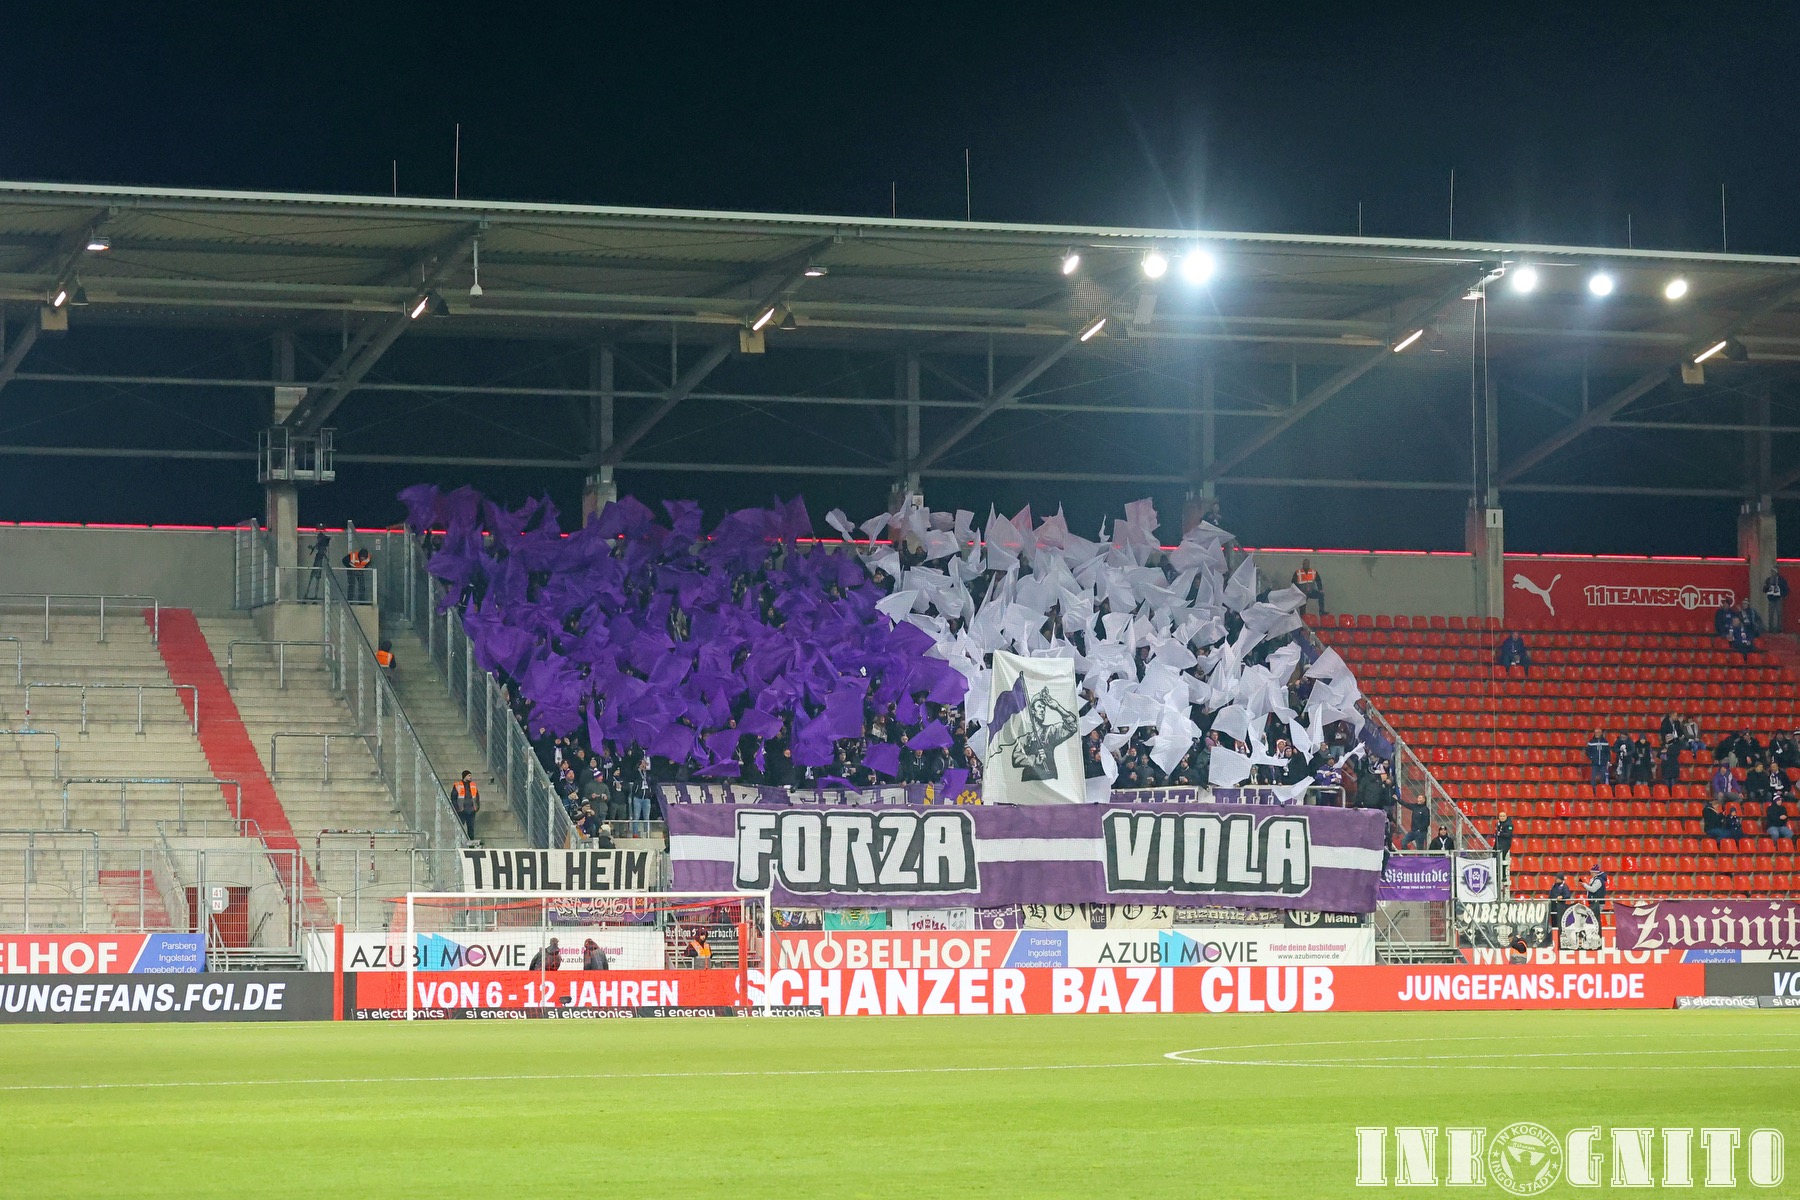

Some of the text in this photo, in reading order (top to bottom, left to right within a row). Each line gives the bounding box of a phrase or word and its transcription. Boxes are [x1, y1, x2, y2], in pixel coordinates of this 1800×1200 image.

[736, 810, 1310, 896] FORZA VIOLA
[464, 850, 648, 891] THALHEIM
[1379, 869, 1450, 882] Wismutadle
[213, 889, 222, 898] 41
[1324, 913, 1358, 925] Mann
[1463, 902, 1546, 925] OLBERNHAU
[161, 942, 197, 951] Parsberg
[1030, 938, 1062, 947] Parsberg
[1027, 949, 1062, 958] Ingolstadt
[1098, 941, 1258, 963] AZUBI MOVIE
[1269, 944, 1347, 953] Finde deine Ausbildung!
[0, 942, 117, 973] LHOF
[158, 954, 197, 963] Ingolstadt
[440, 945, 526, 967] MOVIE
[144, 966, 197, 974] moebelhof.de
[735, 966, 1335, 1016] SCHANZER BAZI CLUB
[1398, 973, 1645, 1001] JUNGEFANS.FCI.DE
[417, 981, 479, 1008] VON
[486, 981, 503, 1008] 6
[523, 981, 557, 1008] 12
[561, 980, 679, 1007] JAHREN
[1680, 996, 1756, 1006] si electronics
[1772, 996, 1783, 1006] si
[356, 1008, 369, 1019] si
[466, 1008, 527, 1019] si energy
[547, 1008, 633, 1019] si electronics
[654, 1007, 716, 1018] si energy
[737, 1008, 749, 1018] si
